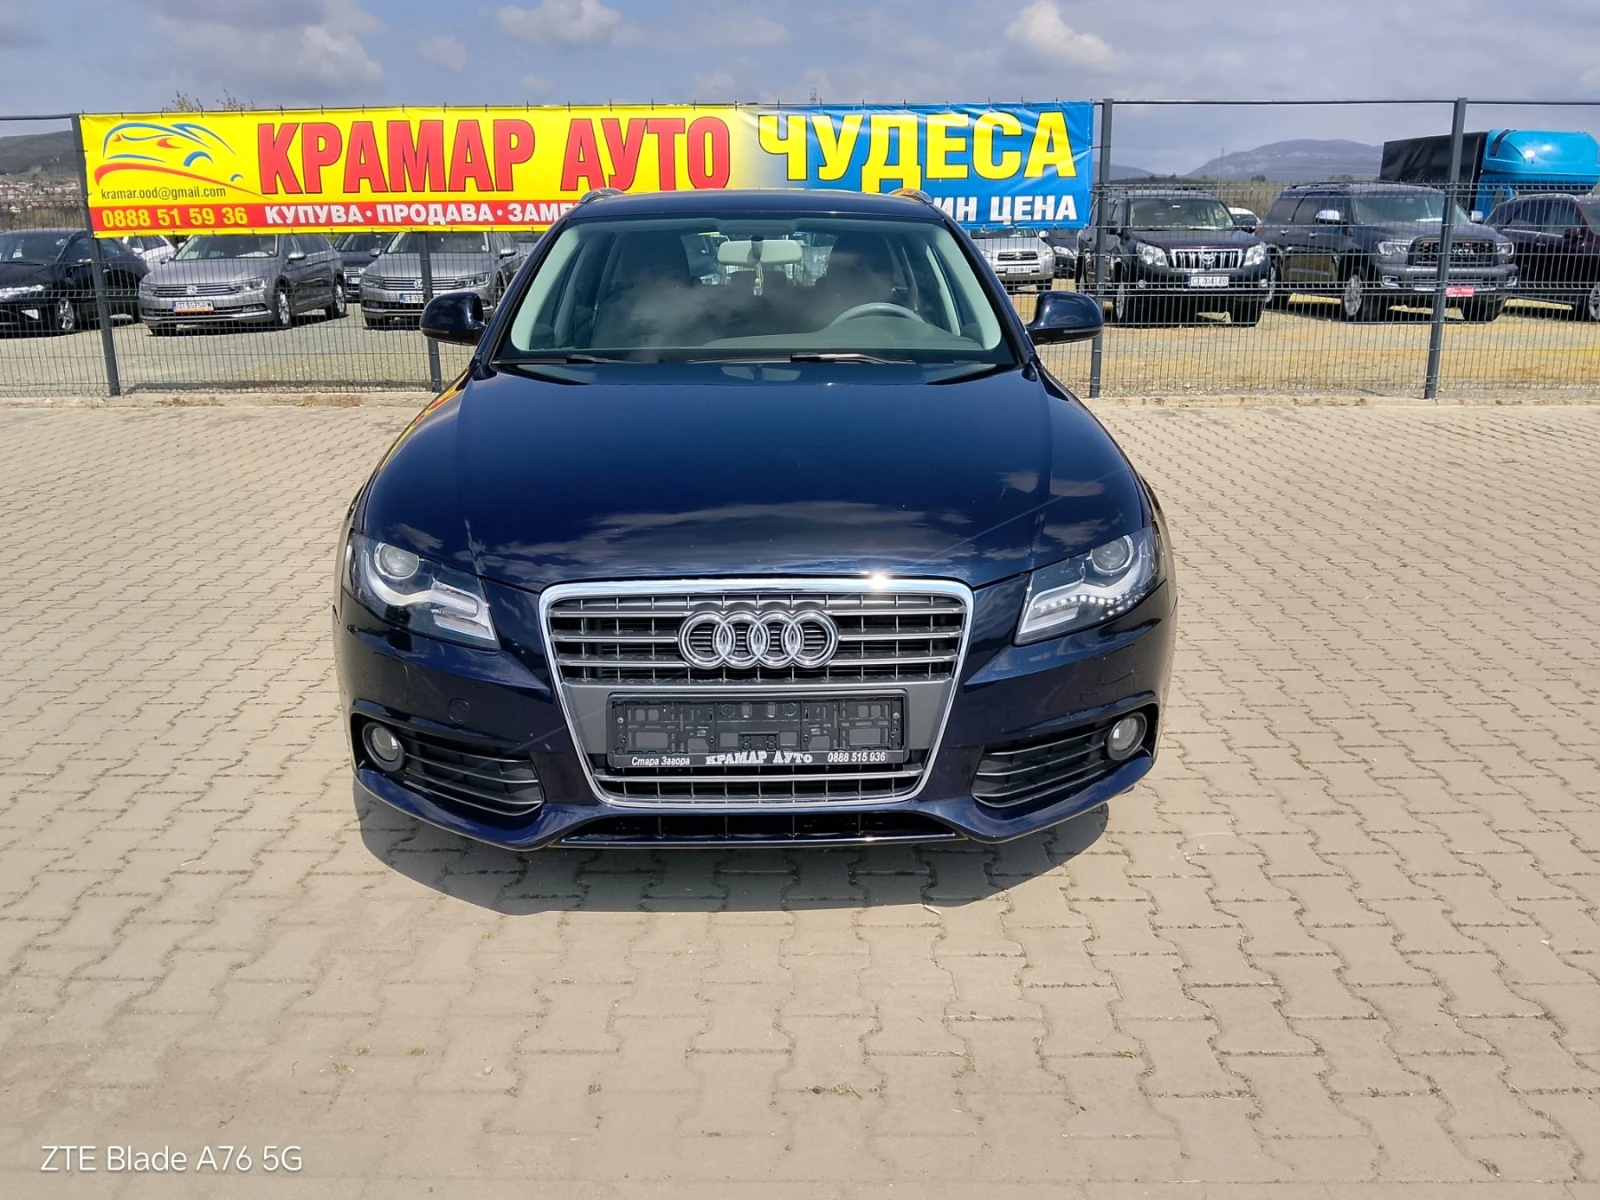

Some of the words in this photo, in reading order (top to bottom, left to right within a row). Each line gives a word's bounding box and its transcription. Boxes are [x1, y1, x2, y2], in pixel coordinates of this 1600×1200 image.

[257, 118, 536, 195] КРАМАР
[560, 116, 731, 191] АУТО
[758, 111, 1078, 194] ЧУДЕСА
[101, 186, 227, 201] kramar.ood@gmail.com
[102, 209, 151, 228] 0888
[157, 208, 181, 226] 51
[189, 207, 215, 225] 59
[222, 206, 248, 225] 36
[264, 204, 364, 224] КУПУВА
[376, 203, 494, 225] ПРОДАВА
[990, 195, 1078, 225] ЦЕНА
[631, 757, 660, 767] Стара
[661, 756, 691, 766] Загора
[705, 750, 767, 765] КРАМАР
[827, 752, 849, 763] 0888
[851, 752, 868, 762] 515
[869, 751, 887, 762] 936
